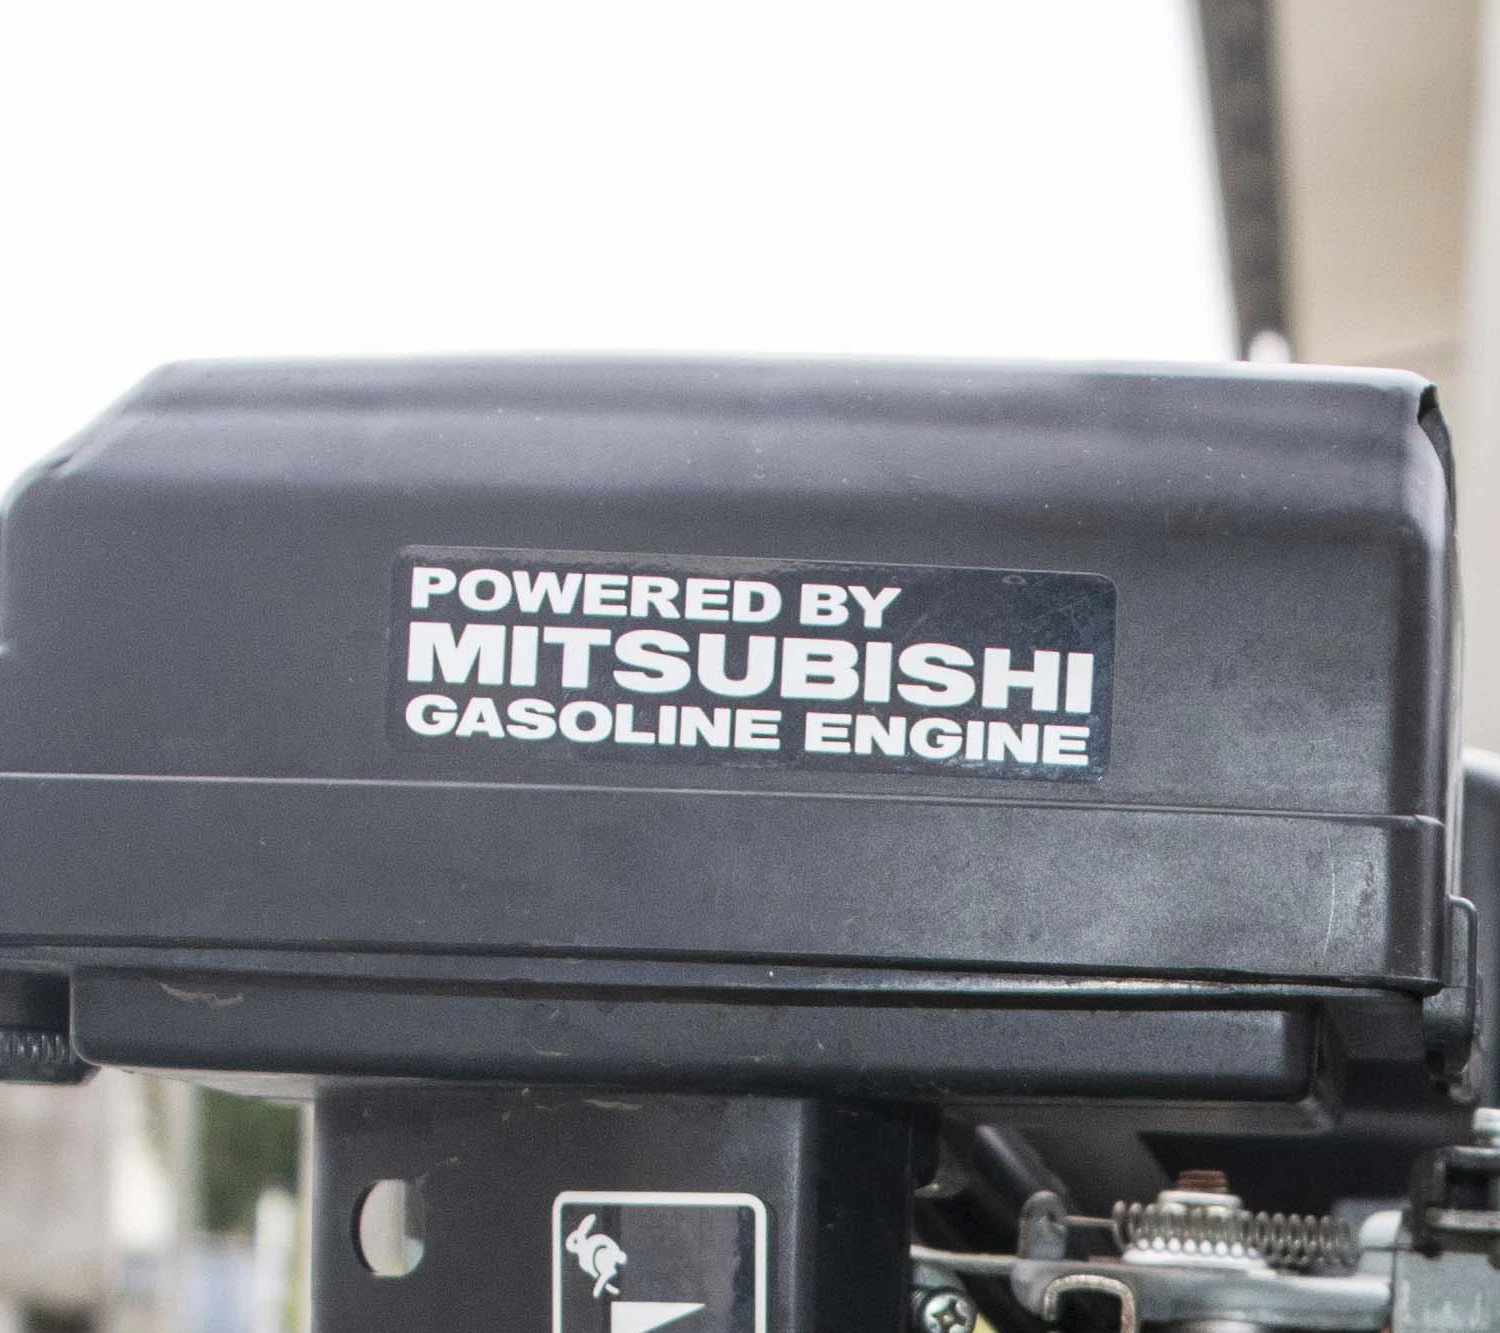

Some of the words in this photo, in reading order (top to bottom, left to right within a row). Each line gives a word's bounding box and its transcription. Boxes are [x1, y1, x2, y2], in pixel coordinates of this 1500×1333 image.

[410, 566, 782, 623] POWERED
[799, 582, 903, 629] BY
[406, 621, 1095, 714] MITSUBISHI
[405, 694, 782, 751] GASOLINE
[803, 711, 1090, 766] ENGINE
